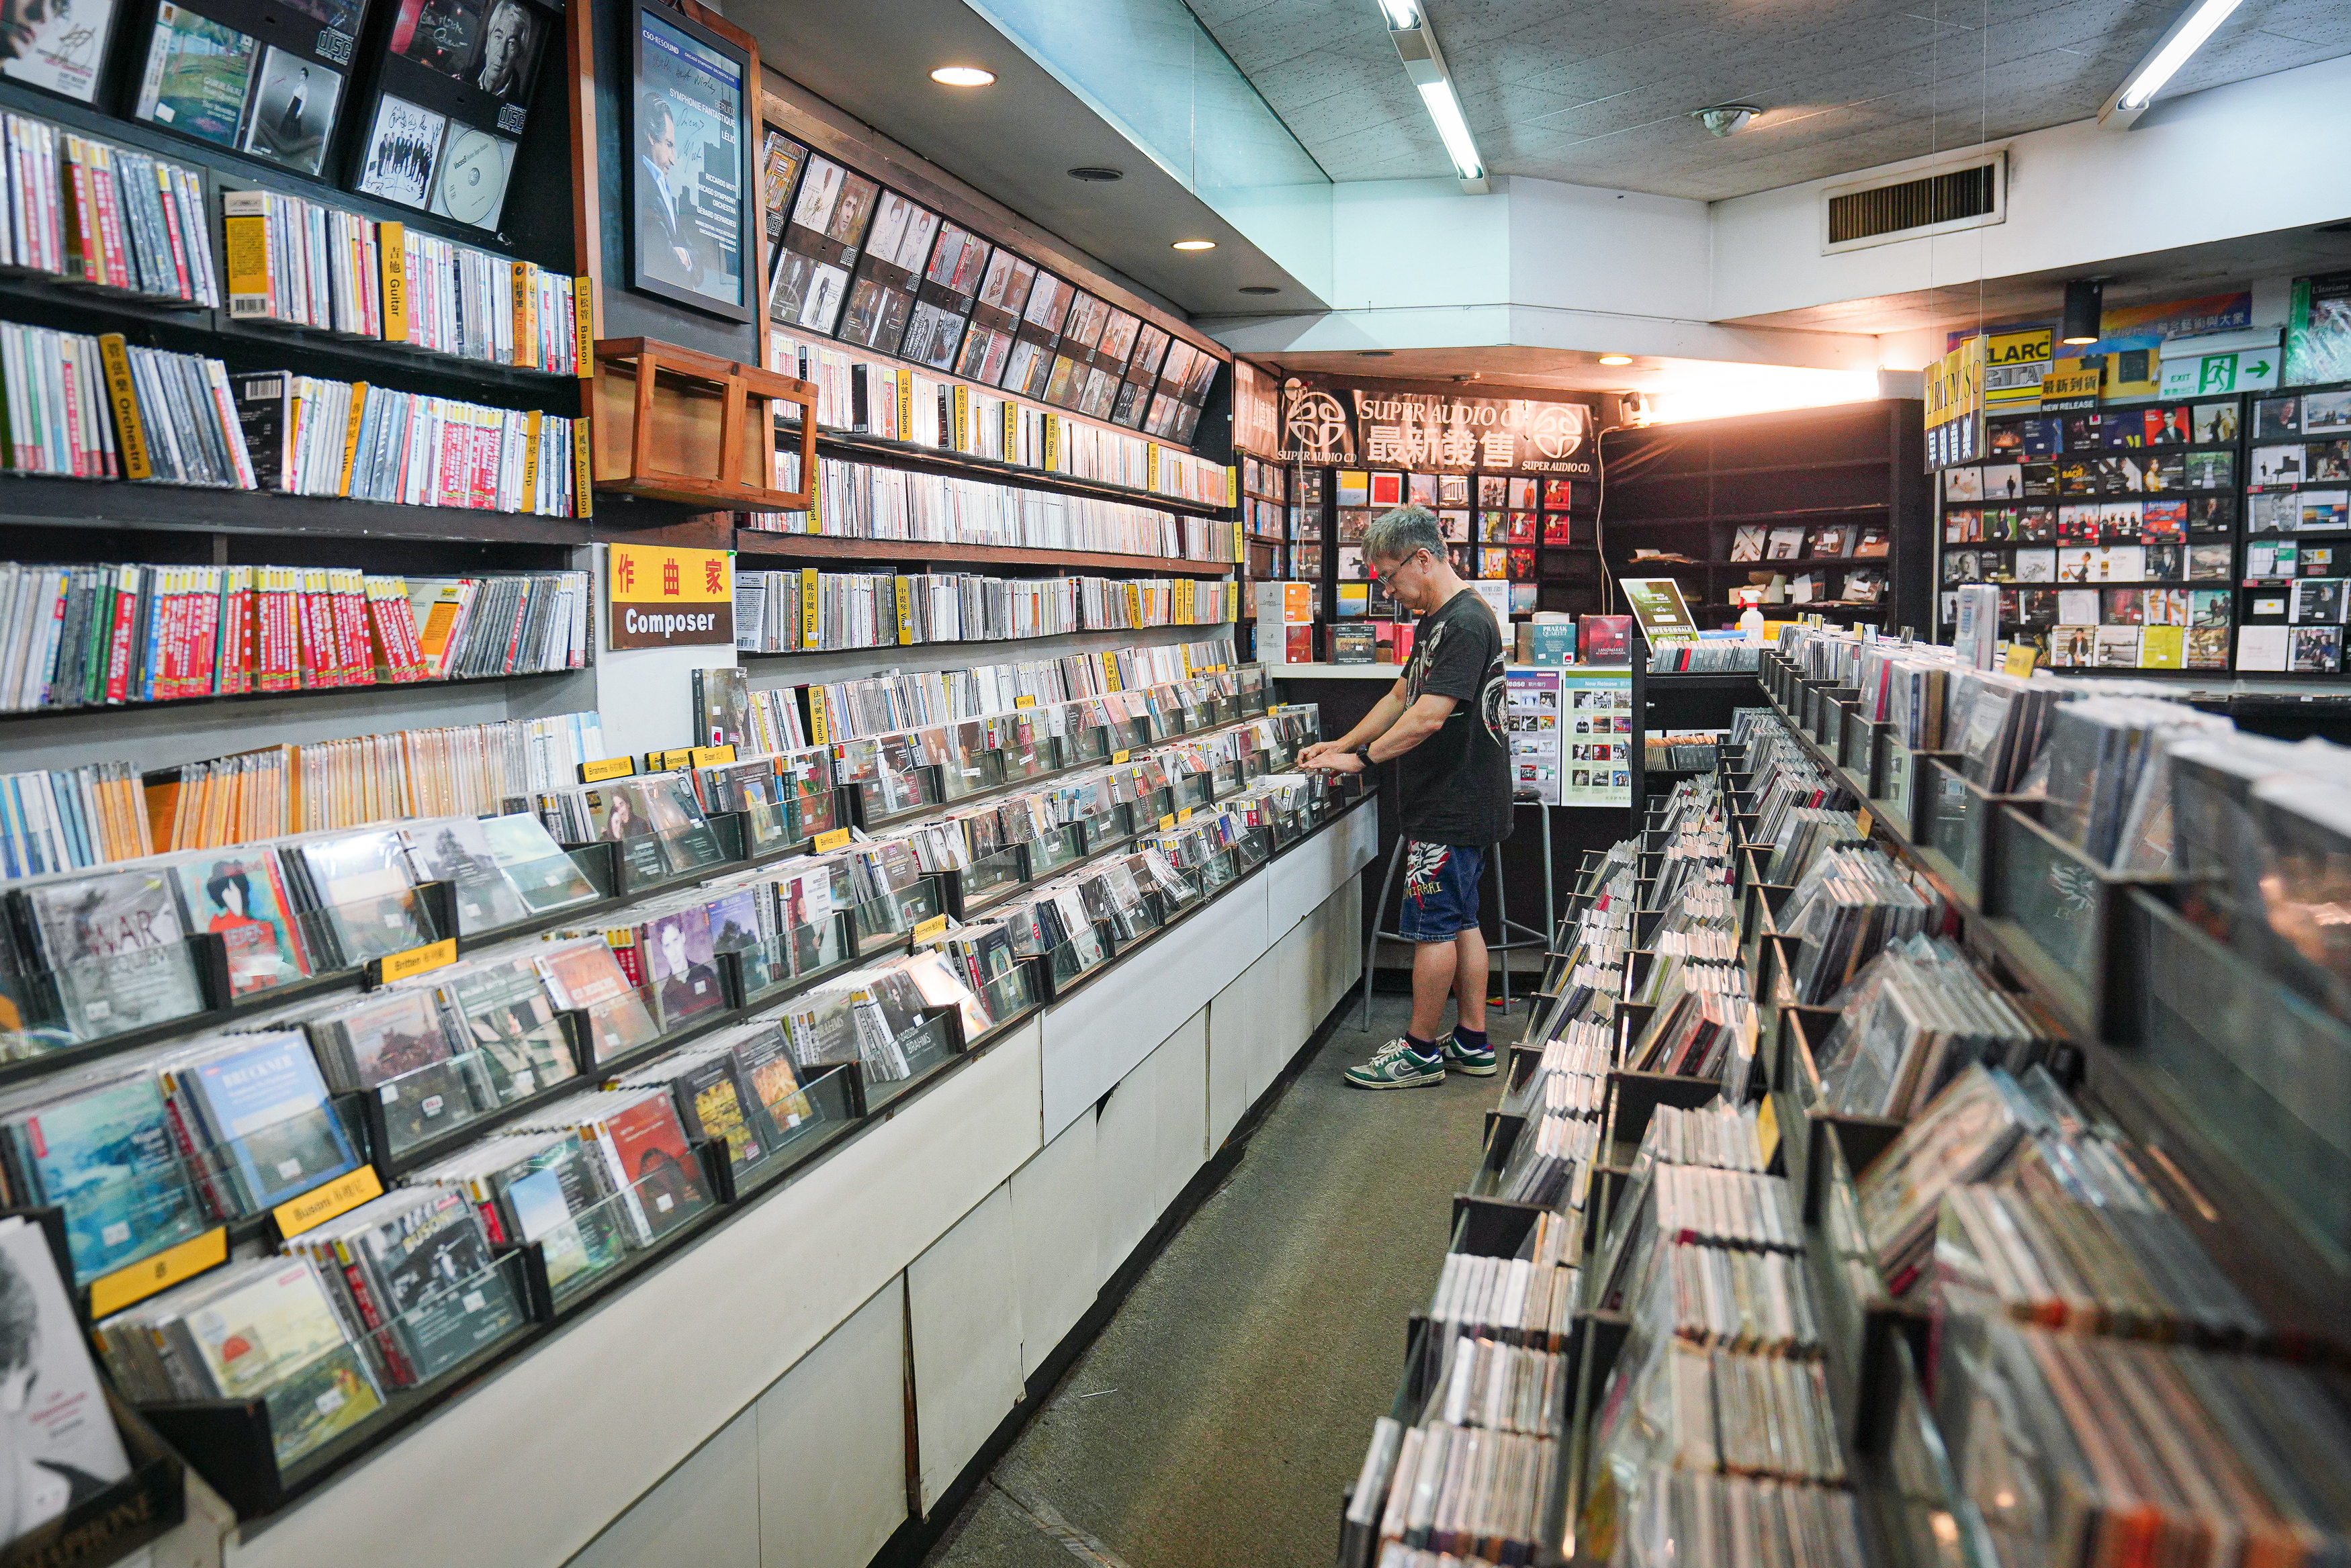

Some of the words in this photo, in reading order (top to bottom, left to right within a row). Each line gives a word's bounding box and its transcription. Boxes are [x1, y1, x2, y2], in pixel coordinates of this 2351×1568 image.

[317, 26, 352, 62] disc
[499, 103, 526, 129] disc
[510, 104, 527, 115] COMPACT
[670, 88, 701, 111] SYMPHONIE
[702, 103, 736, 128] FANTASTIQUE
[715, 99, 736, 117] BERLIOZ
[497, 122, 511, 132] DIGITAL
[511, 126, 523, 134] AUDIO
[721, 130, 736, 144] LÉLIO
[705, 173, 725, 188] RICCARDO
[726, 182, 736, 193] MUTI
[696, 183, 713, 196] CHICAGO
[714, 190, 736, 205] SYMPHONY
[713, 199, 736, 215] ORCHESTRA
[697, 206, 713, 218] GÉRARD
[714, 214, 736, 228] DEPARDIEU
[390, 279, 400, 317] Guitar
[901, 378, 908, 394] 長號
[2043, 376, 2097, 395] 最新到貨
[2170, 373, 2191, 383] EXIT
[1360, 400, 1425, 422] SUPER
[1429, 404, 1497, 427] AUDIO
[1500, 407, 1527, 428] CD
[2041, 403, 2058, 412] NEW
[2059, 400, 2094, 411] RELEASE
[119, 398, 142, 471] Orchestra
[1367, 425, 1515, 468] 最新發售
[1278, 450, 1310, 462] SUPER
[1310, 452, 1343, 463] AUDIO
[1343, 453, 1357, 463] CD
[524, 461, 535, 487] Harp
[1521, 460, 1550, 471] SUPER
[1550, 462, 1578, 472] AUDIO
[1578, 463, 1591, 473] CD
[617, 554, 723, 595] 作曲家
[806, 582, 815, 610] 低音號
[899, 588, 907, 611] 中提琴
[625, 607, 715, 638] Composer
[813, 690, 822, 714] 法國號
[666, 756, 687, 765] Bernstein
[705, 753, 715, 761] Bizet
[588, 766, 608, 775] Brahms
[820, 837, 834, 846] Berlioz
[916, 924, 932, 936] Boccherini
